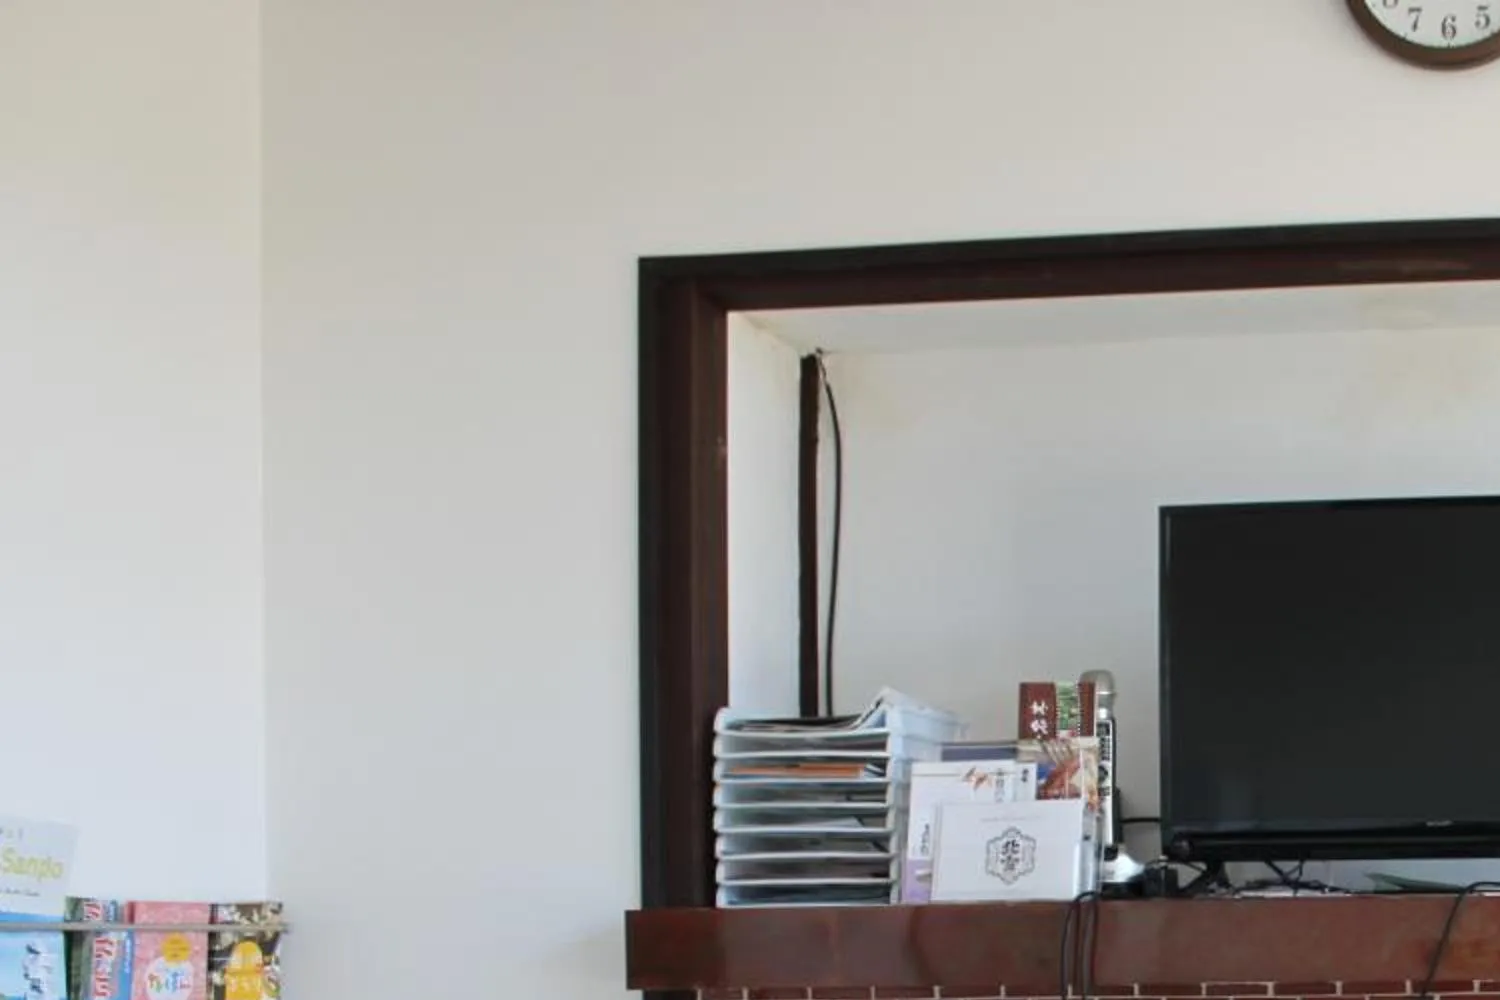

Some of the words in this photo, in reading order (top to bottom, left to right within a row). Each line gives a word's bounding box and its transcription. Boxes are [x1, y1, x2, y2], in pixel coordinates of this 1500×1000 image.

[1408, 7, 1422, 32] 7
[1441, 14, 1457, 40] 6
[1475, 5, 1491, 30] 5
